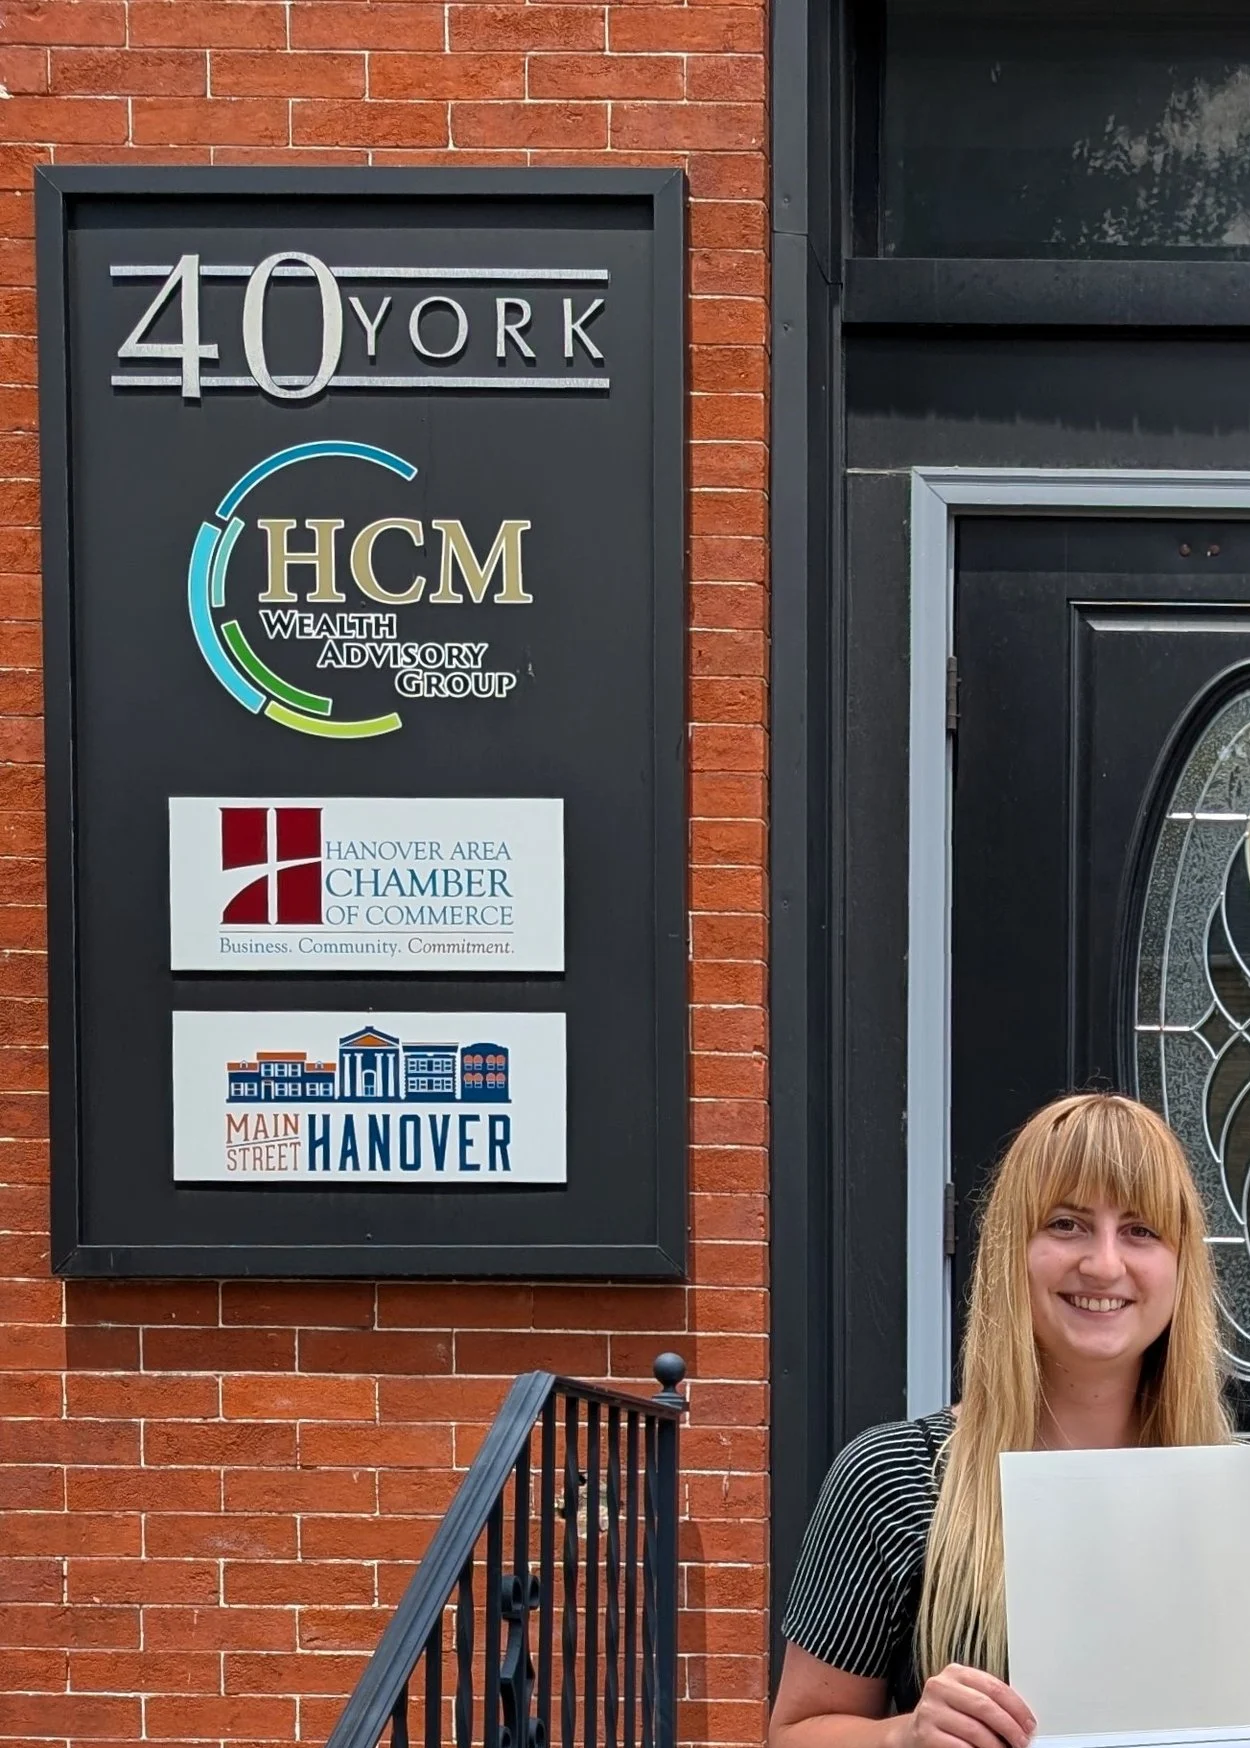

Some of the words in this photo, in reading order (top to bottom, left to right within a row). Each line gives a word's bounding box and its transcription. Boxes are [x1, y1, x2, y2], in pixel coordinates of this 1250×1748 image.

[116, 251, 343, 399] 40
[348, 296, 606, 359] YORK
[257, 517, 534, 606] HCM
[258, 610, 398, 640] WEALTH
[317, 640, 489, 670] ADVISORY
[394, 669, 517, 699] GROUP
[325, 840, 444, 862] HANOVER
[450, 840, 512, 861] AREA
[325, 867, 514, 899] CHAMBER
[325, 905, 359, 926] OF
[365, 905, 514, 926] COMMERCE
[219, 937, 293, 955] Business.
[298, 937, 402, 959] Community.
[407, 937, 515, 955] Commitment.
[226, 1112, 300, 1144] MAIN
[307, 1112, 512, 1172] HANOVER
[226, 1141, 301, 1172] STREET
